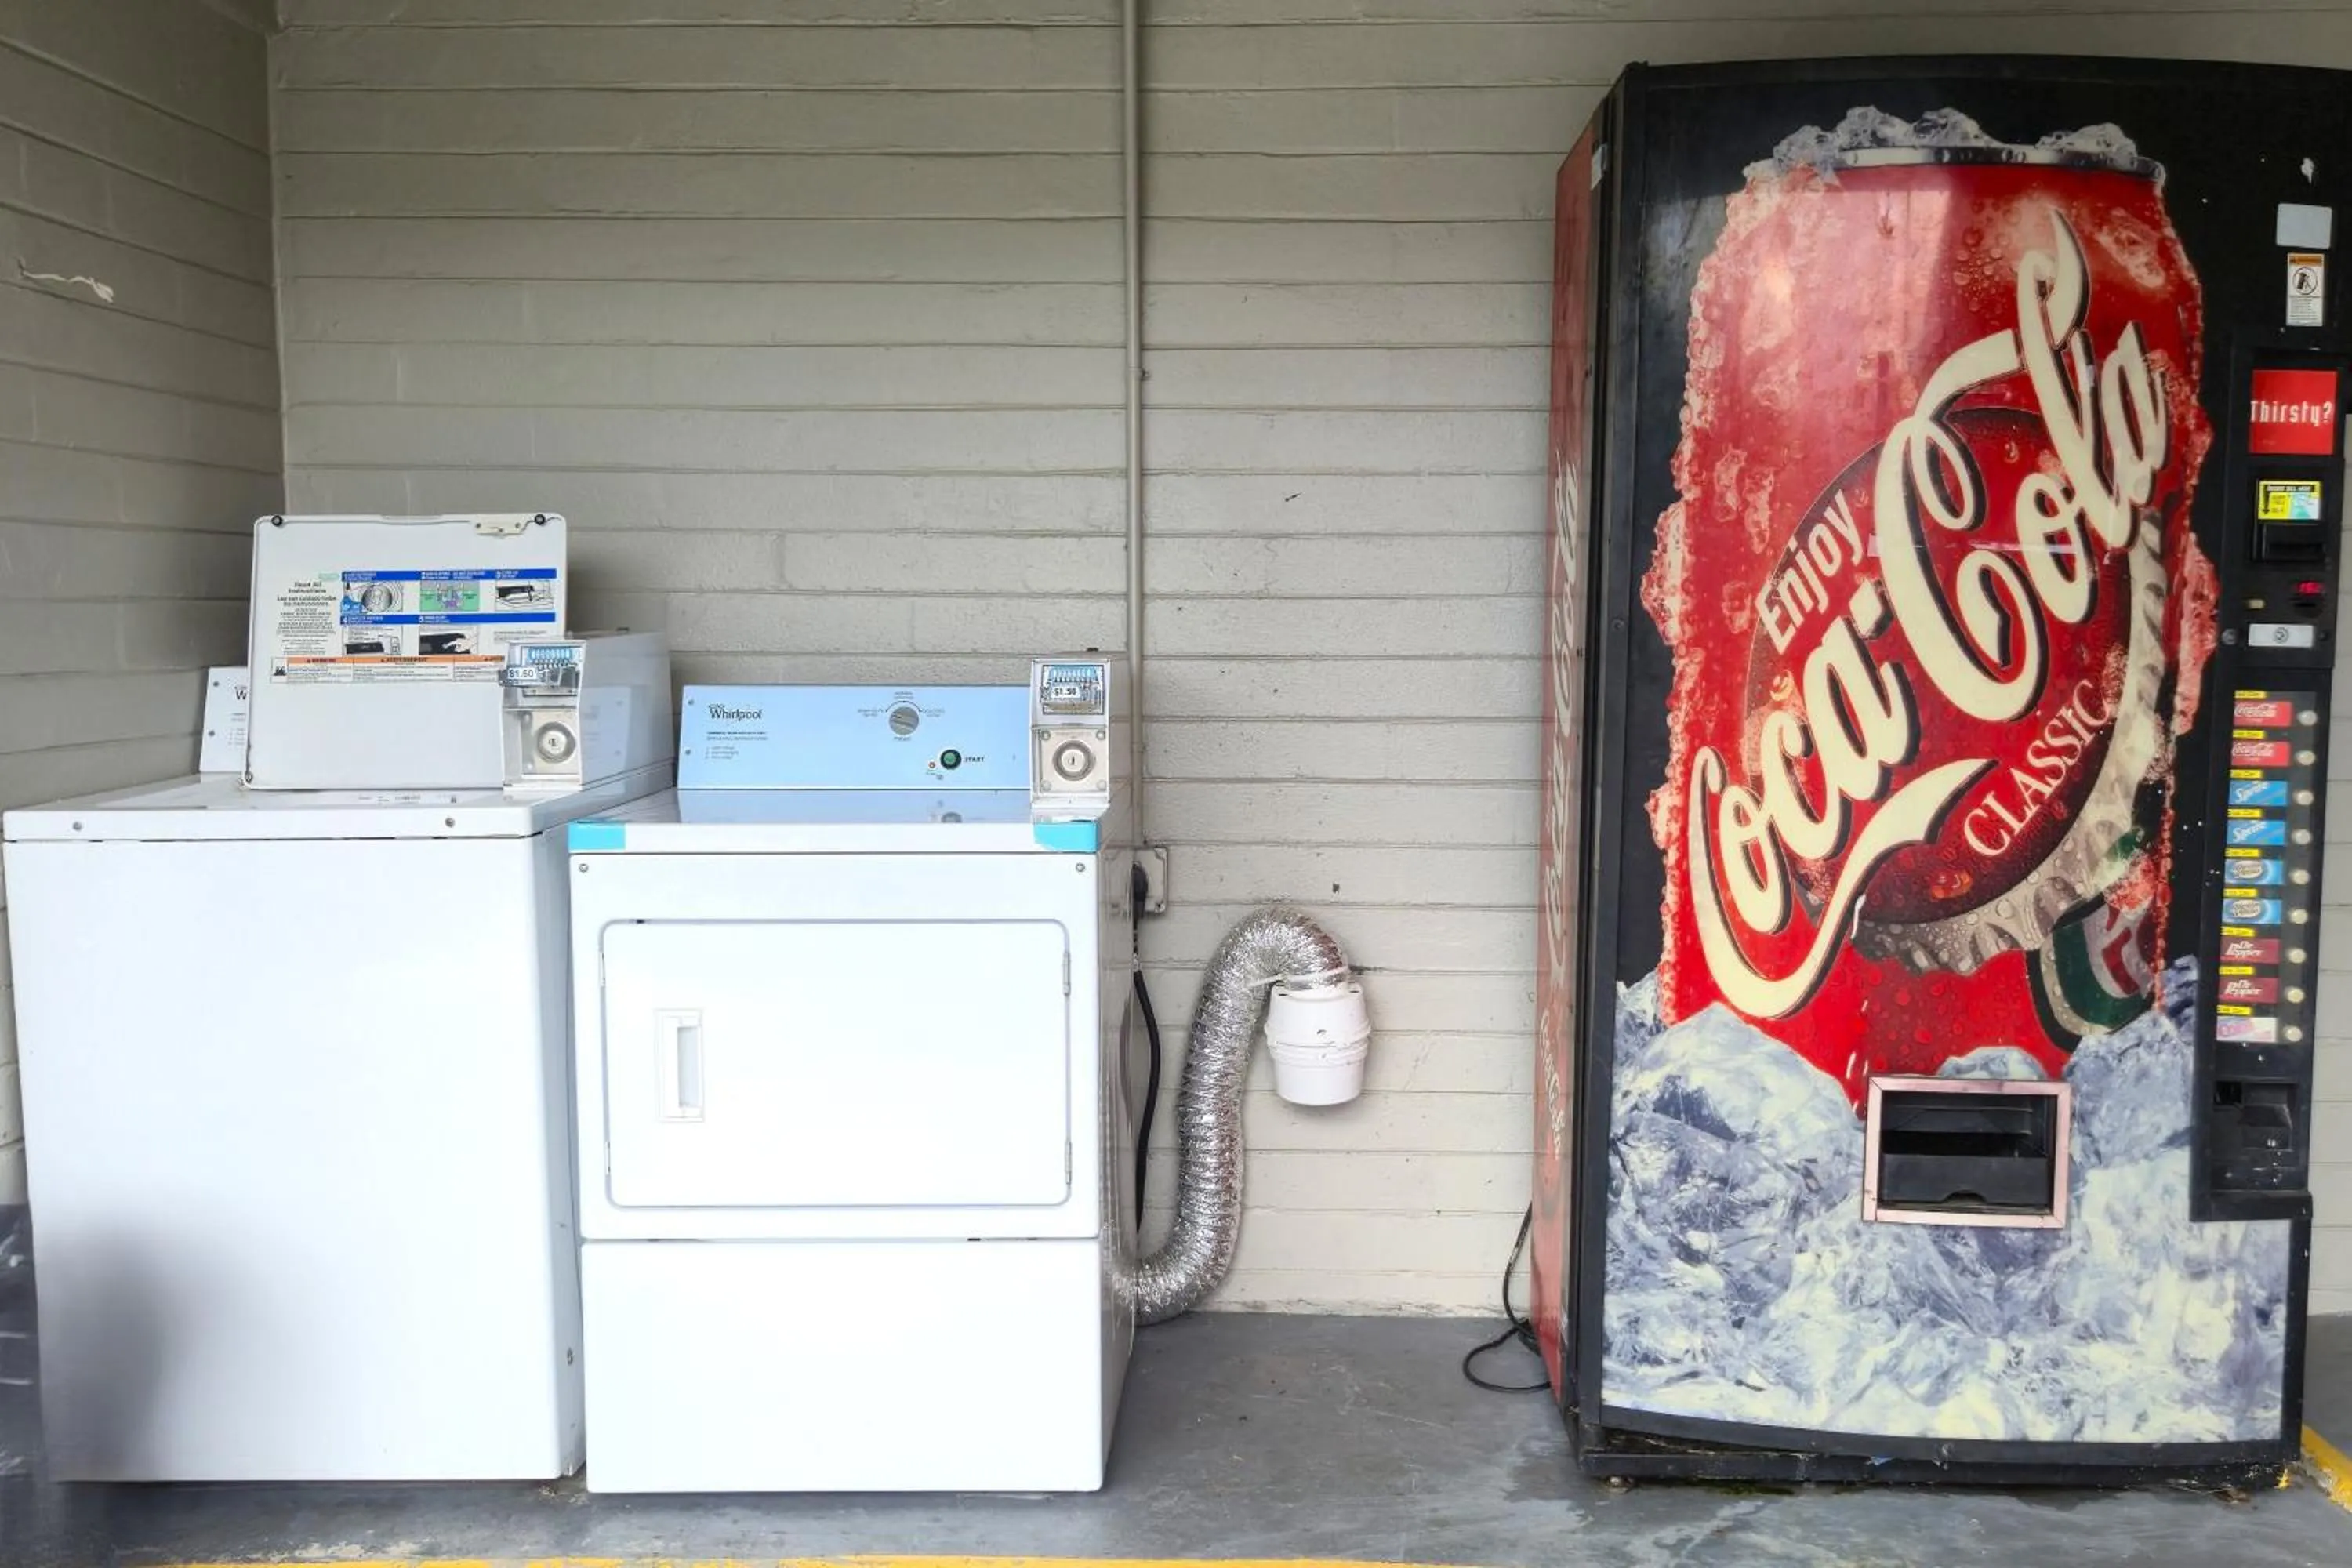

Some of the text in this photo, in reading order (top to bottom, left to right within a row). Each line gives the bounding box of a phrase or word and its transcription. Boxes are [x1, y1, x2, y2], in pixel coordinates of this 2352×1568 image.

[2250, 401, 2333, 427] Thirsty?
[1755, 489, 1863, 655] Enjoy
[1687, 205, 2169, 1021] Coca-Cola
[509, 669, 534, 678] $1.50
[708, 703, 763, 722] Whirlpool
[1962, 677, 2111, 857] CLASSIC
[2234, 779, 2268, 803] Sprite
[2232, 819, 2267, 843] Sprite
